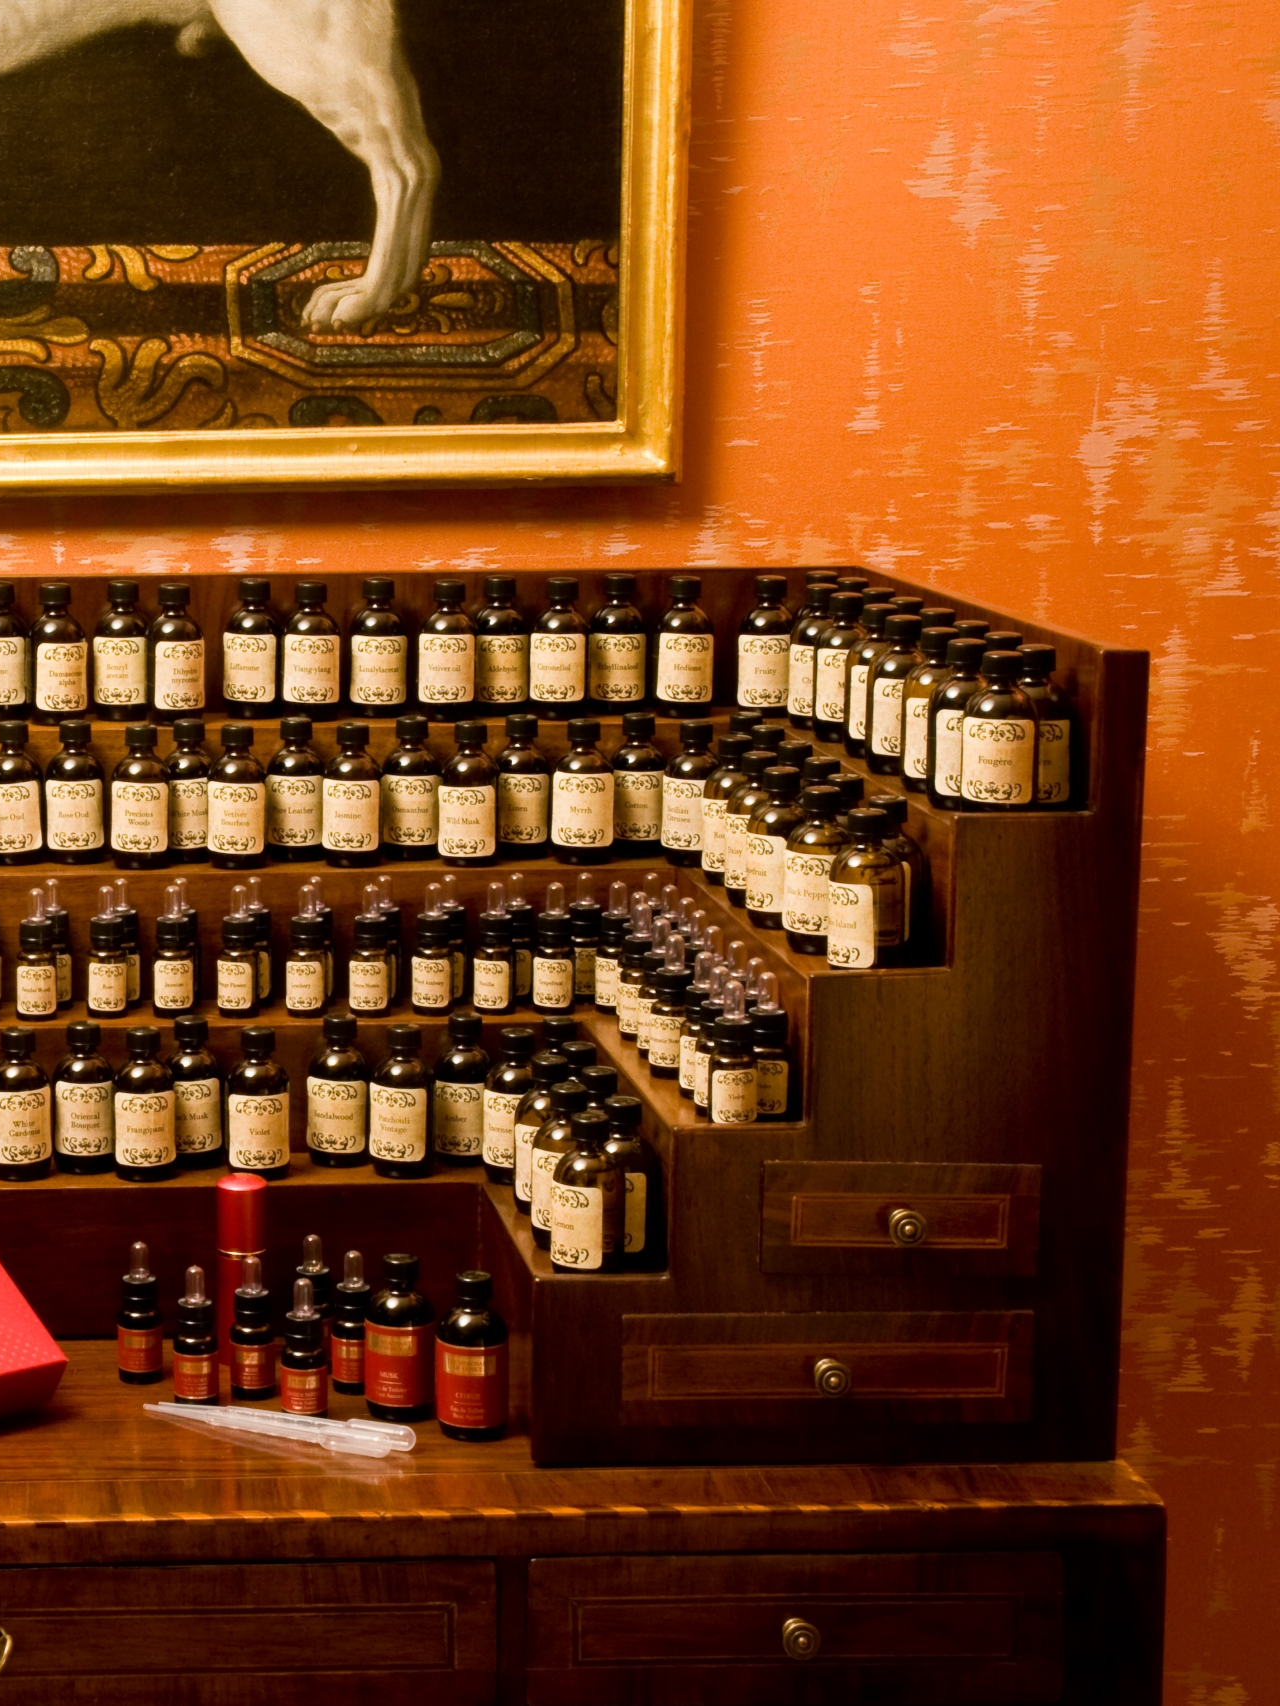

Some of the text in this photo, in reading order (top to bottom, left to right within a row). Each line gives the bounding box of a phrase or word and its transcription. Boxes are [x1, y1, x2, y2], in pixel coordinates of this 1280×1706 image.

[106, 663, 128, 672] Benzyl
[293, 664, 331, 675] Ylang-ylang
[428, 664, 461, 672] Vetiver oil
[487, 664, 518, 673] Aldehyde
[537, 663, 571, 671] Citronellol
[673, 663, 702, 671] Hedione
[754, 667, 778, 676] Fruity
[978, 756, 1012, 767] Fougère
[392, 806, 429, 814] Osmanthus
[507, 804, 528, 812] Linen
[569, 806, 593, 815] Myrrh
[124, 810, 154, 818] Precious
[223, 810, 248, 818] Vetiver
[334, 811, 362, 819] Jasmine
[128, 818, 151, 826] Woods
[220, 818, 250, 826] Bourbon
[461, 817, 481, 825] Musk
[70, 1112, 100, 1120] Oriental
[313, 1111, 354, 1121] Sandalwood
[378, 1115, 410, 1125] Patchouli
[71, 1121, 101, 1129] Bouquet
[380, 1124, 407, 1134] Vintage
[488, 1123, 512, 1134] Incense
[249, 1127, 270, 1136] Violet
[553, 1217, 575, 1230] Lemon
[379, 1371, 398, 1379] MUSK
